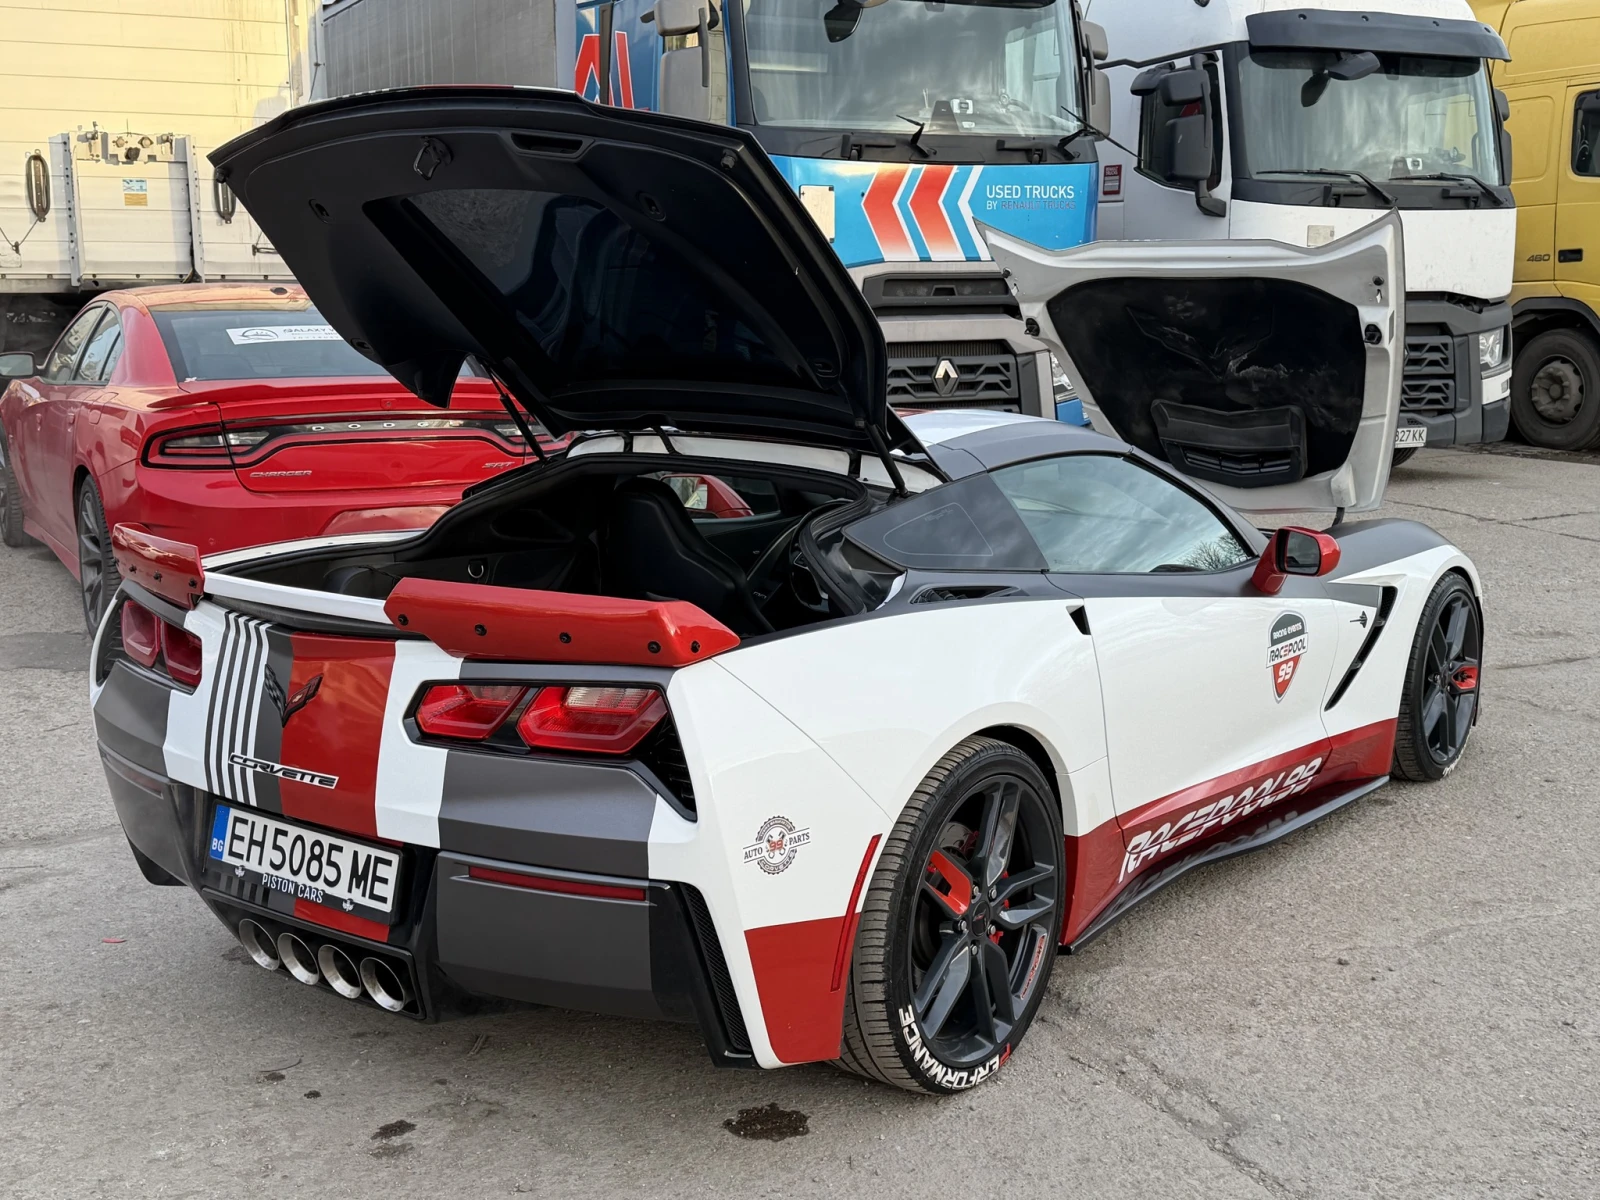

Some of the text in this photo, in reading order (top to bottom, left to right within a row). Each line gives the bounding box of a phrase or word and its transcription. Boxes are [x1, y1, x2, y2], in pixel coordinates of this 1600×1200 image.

[986, 185, 1075, 199] USED TRUCKS
[986, 201, 1076, 210] BY RENAULT TRUCKS
[1526, 253, 1551, 262] 460
[1412, 429, 1425, 442] KK
[249, 469, 313, 478] CHARGER
[1268, 637, 1306, 663] RACEPOOL
[1277, 660, 1294, 684] 99
[229, 753, 338, 788] CORVETTE
[1118, 757, 1323, 884] RACEPOOL99
[211, 837, 224, 852] BG
[743, 832, 810, 860] AUTO PARTS
[769, 839, 784, 852] 99
[261, 873, 324, 904] PISTON CARS
